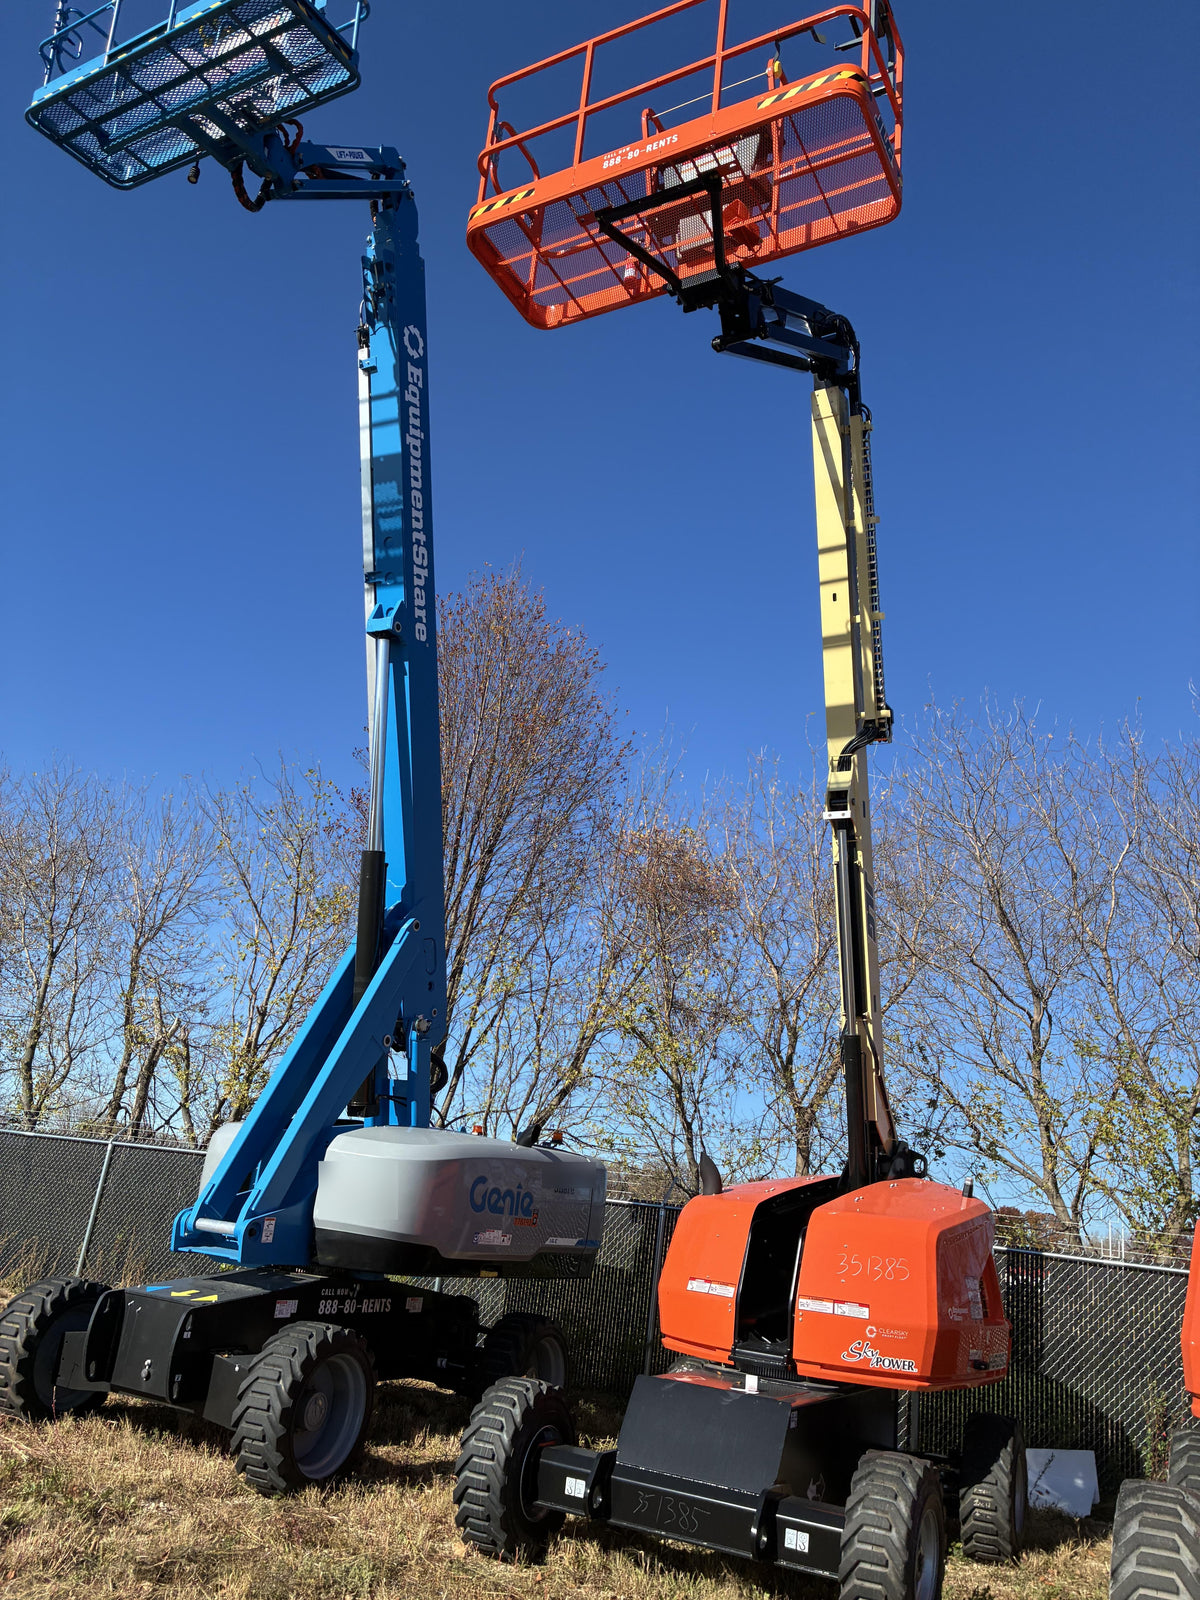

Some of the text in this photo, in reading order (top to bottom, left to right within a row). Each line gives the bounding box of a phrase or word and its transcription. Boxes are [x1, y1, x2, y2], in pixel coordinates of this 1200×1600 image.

[602, 134, 678, 169] 888-80-RENTS
[405, 361, 429, 642] EquipmentShare
[469, 1175, 534, 1217] Genie
[318, 1298, 391, 1315] 888-80-RENTS
[321, 1288, 335, 1296] CALL
